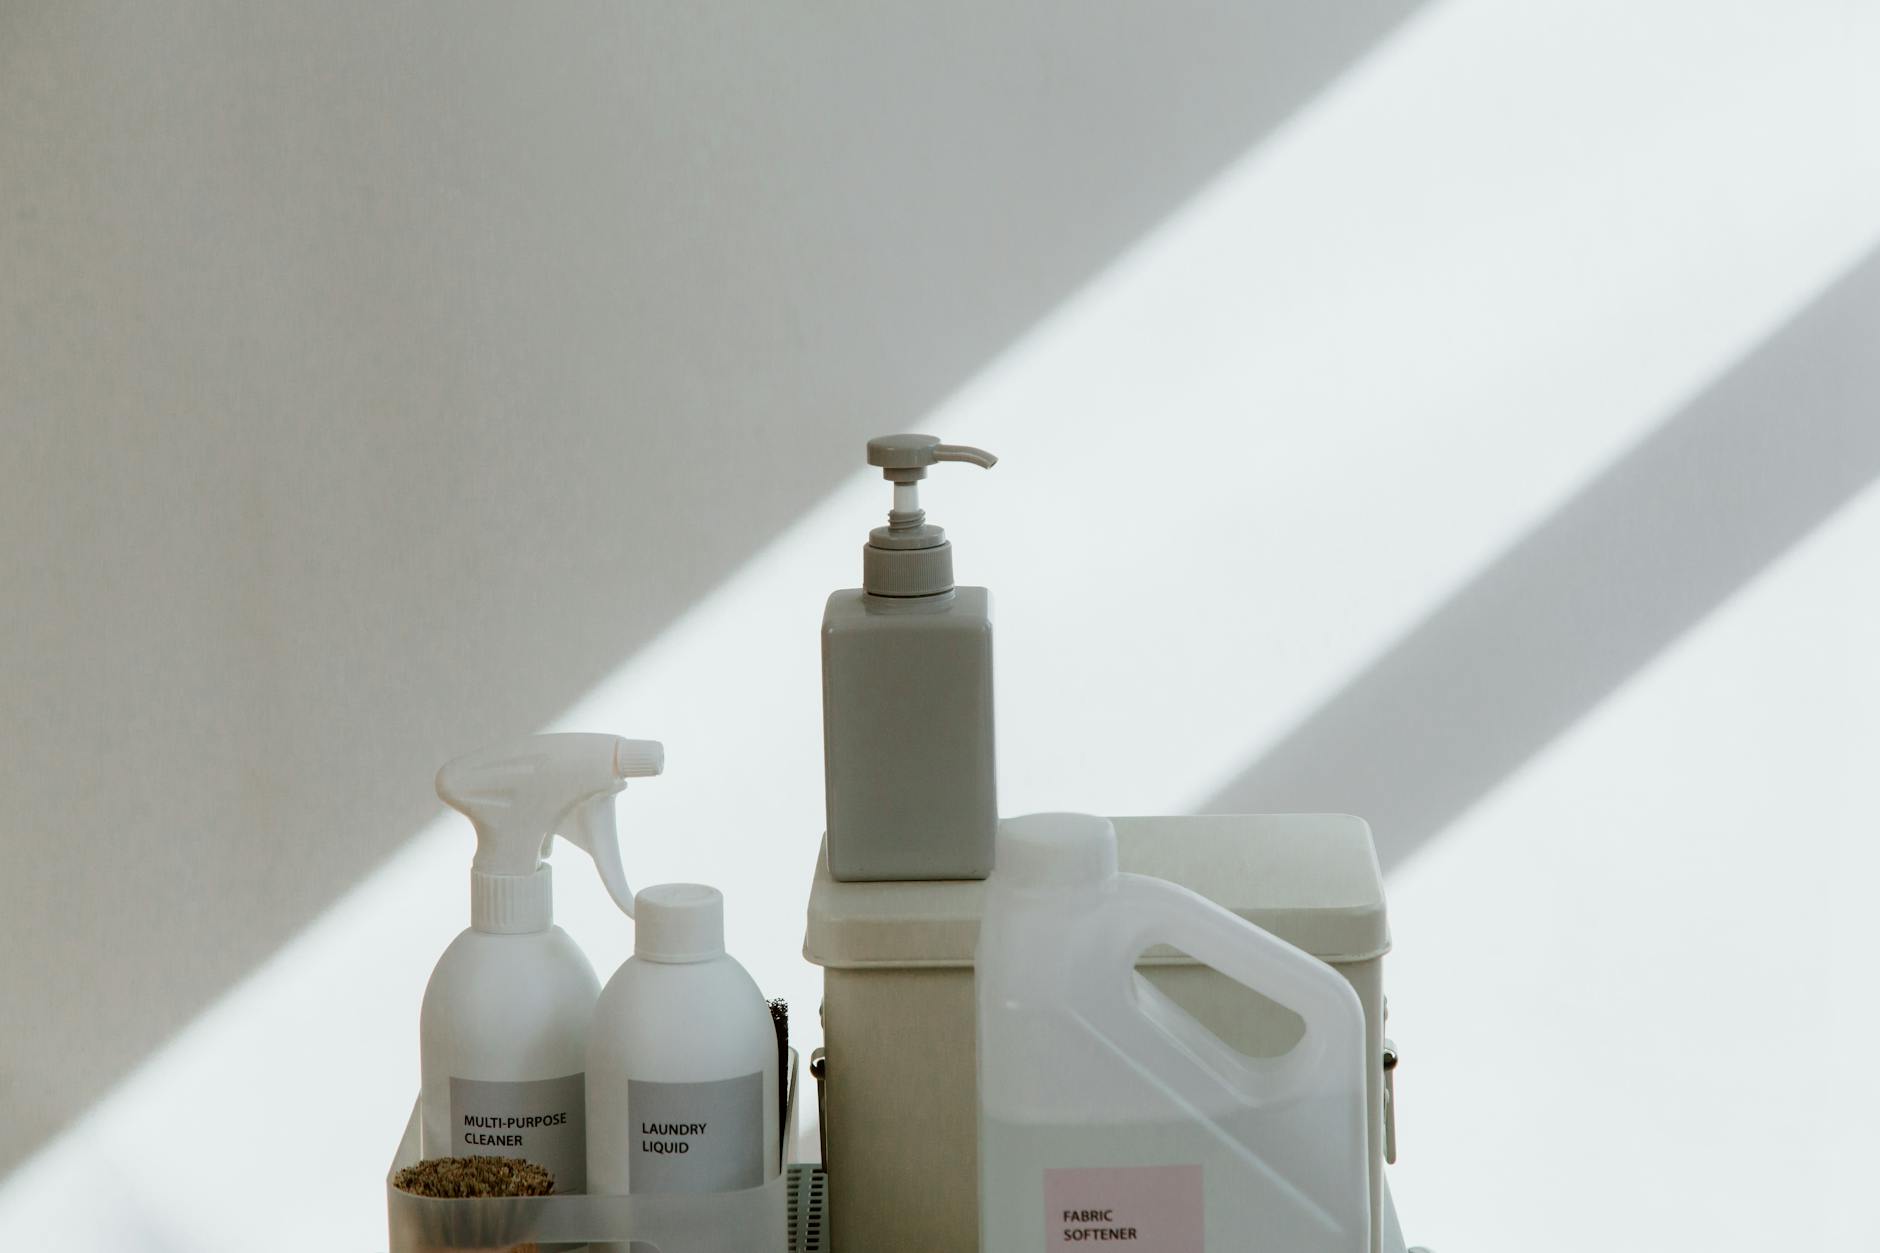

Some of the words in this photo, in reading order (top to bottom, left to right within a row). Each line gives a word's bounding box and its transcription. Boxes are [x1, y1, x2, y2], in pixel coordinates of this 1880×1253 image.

[464, 1112, 567, 1129] MULTI-PURPOSE
[641, 1122, 707, 1136] LAUNDRY
[464, 1132, 523, 1147] CLEANER
[641, 1140, 690, 1155] LIQUID
[1063, 1209, 1113, 1222] FABRIC
[1063, 1227, 1137, 1241] SOFTENER
